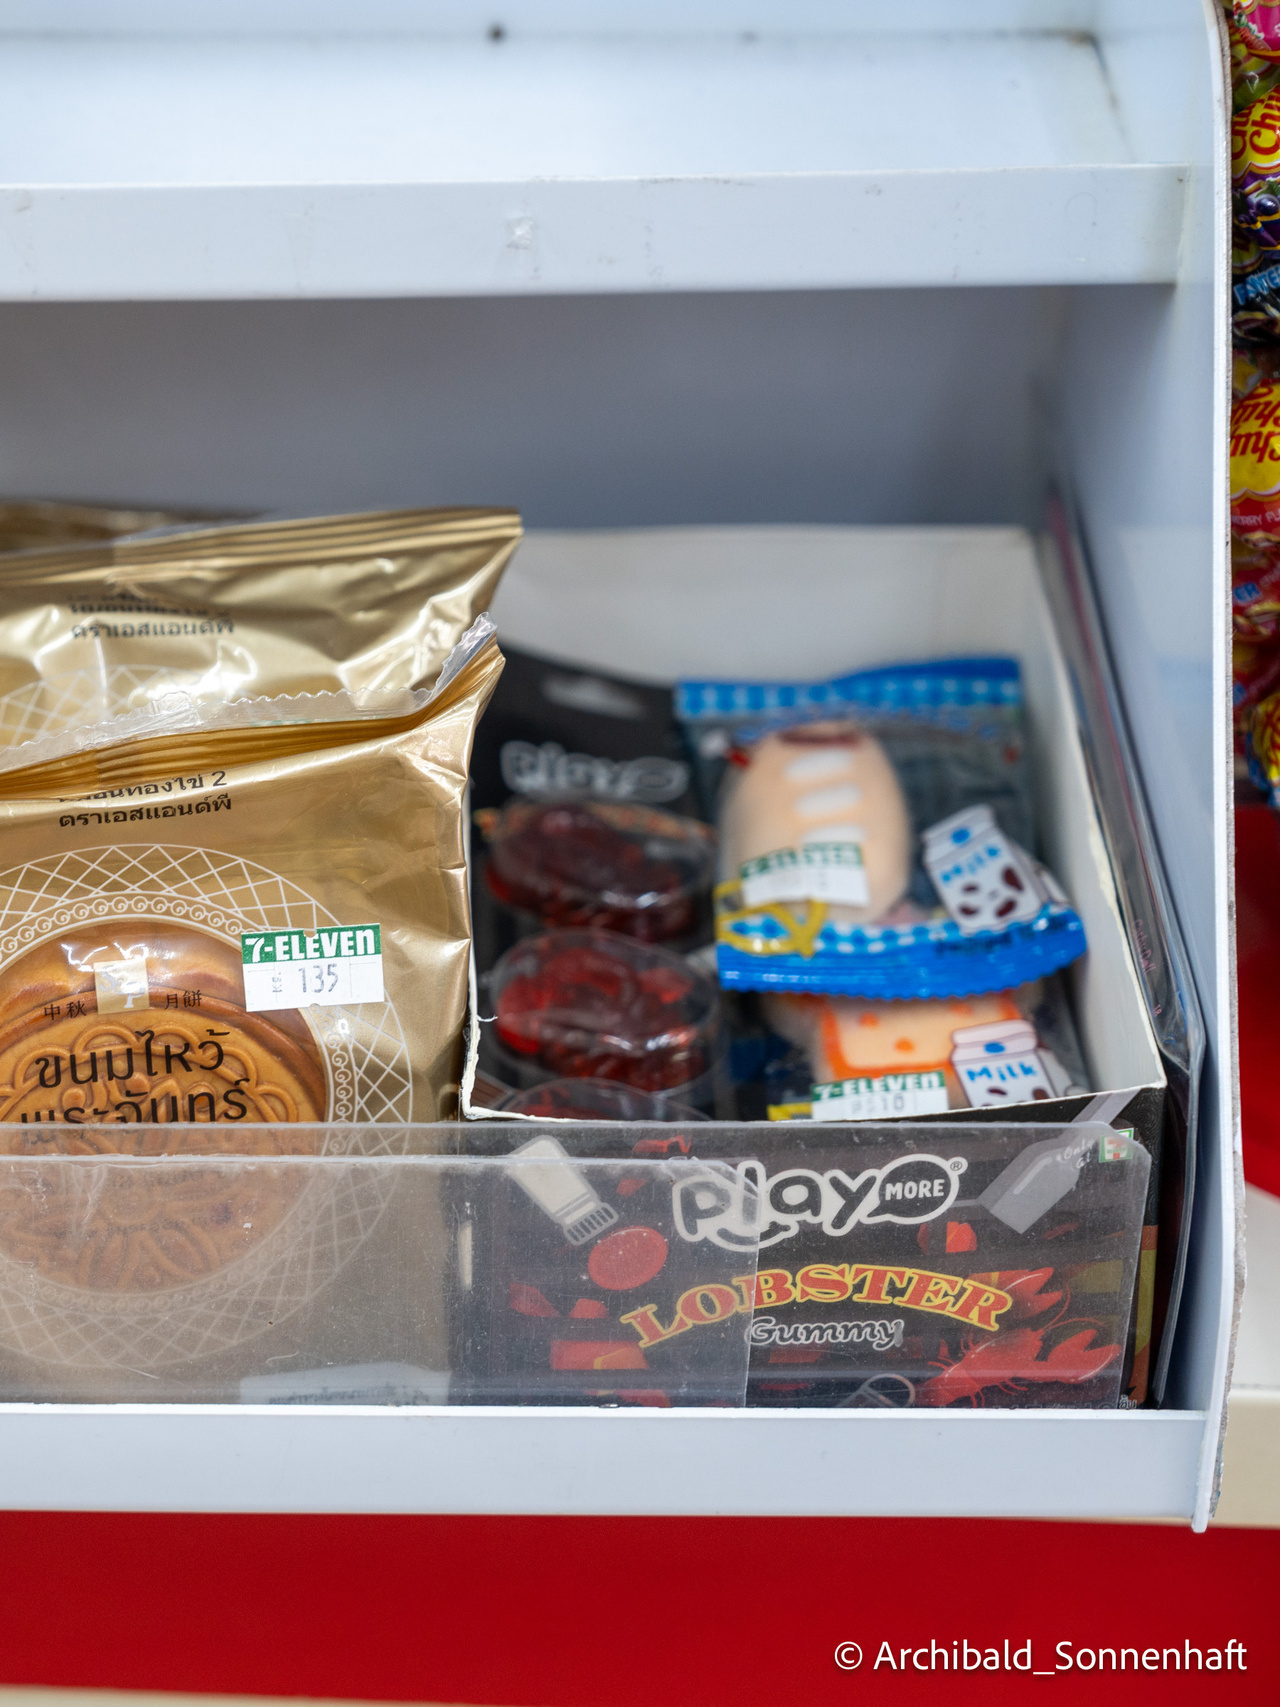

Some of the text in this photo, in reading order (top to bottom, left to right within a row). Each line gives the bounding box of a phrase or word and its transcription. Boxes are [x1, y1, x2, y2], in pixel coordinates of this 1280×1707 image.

[211, 770, 228, 787] 2
[59, 793, 232, 828] ตราเอสแอนด์พี
[298, 963, 339, 994] 135
[44, 1000, 87, 1021] 中秋
[35, 1028, 230, 1089] ขนมไหว้
[884, 1178, 946, 1201] MORE
[621, 1263, 1013, 1349] LOBSTER
[746, 1316, 905, 1351] Gummy
